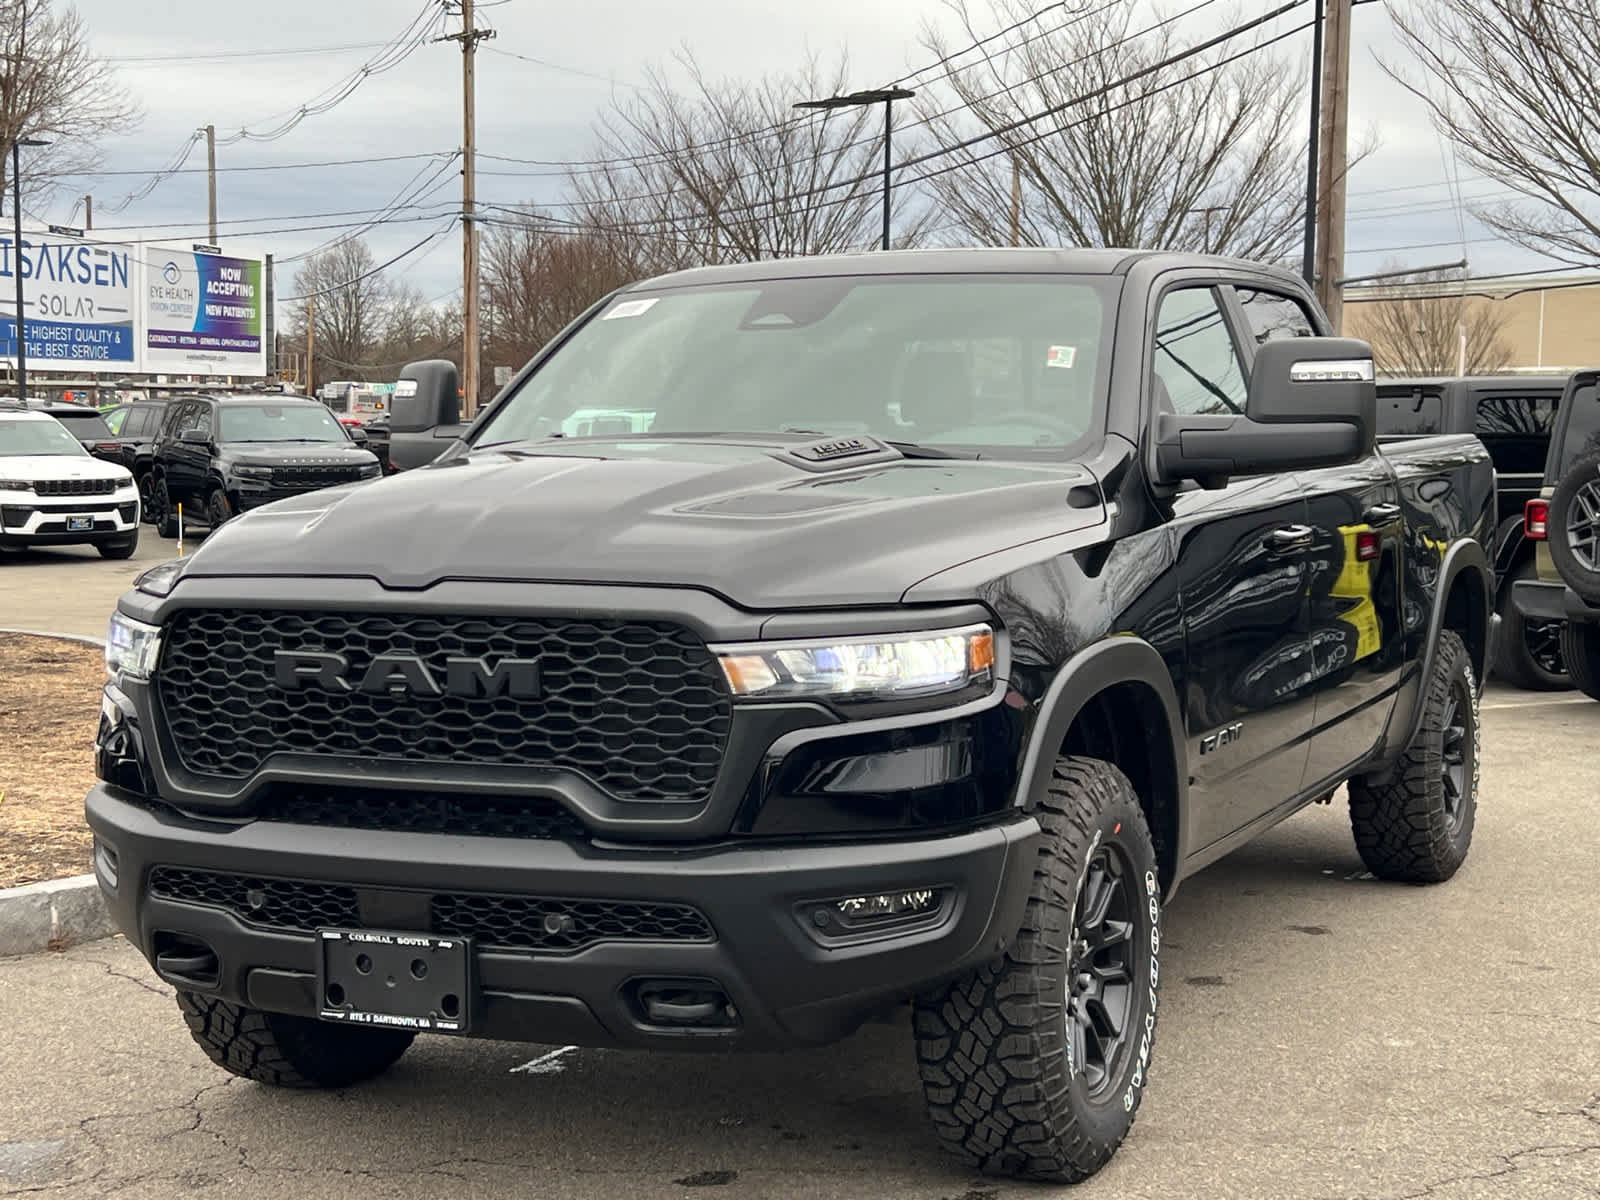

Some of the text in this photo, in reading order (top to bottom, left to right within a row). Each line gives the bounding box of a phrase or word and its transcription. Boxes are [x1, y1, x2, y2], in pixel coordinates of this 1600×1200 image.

[0, 238, 128, 288] ISAKSEN
[220, 267, 241, 282] NOW
[150, 286, 193, 301] EYE HEALTH
[206, 281, 254, 297] ACCEPTING
[39, 294, 94, 318] SOLAR
[205, 303, 222, 316] NEW
[8, 324, 121, 344] TE HIGHEST QUALITY &
[24, 341, 109, 360] THE BEST SERVICE
[273, 650, 543, 697] RAM
[348, 932, 394, 944] COLONIAL
[397, 937, 430, 947] SOUTH
[1123, 870, 1160, 1112] GOODYEAR
